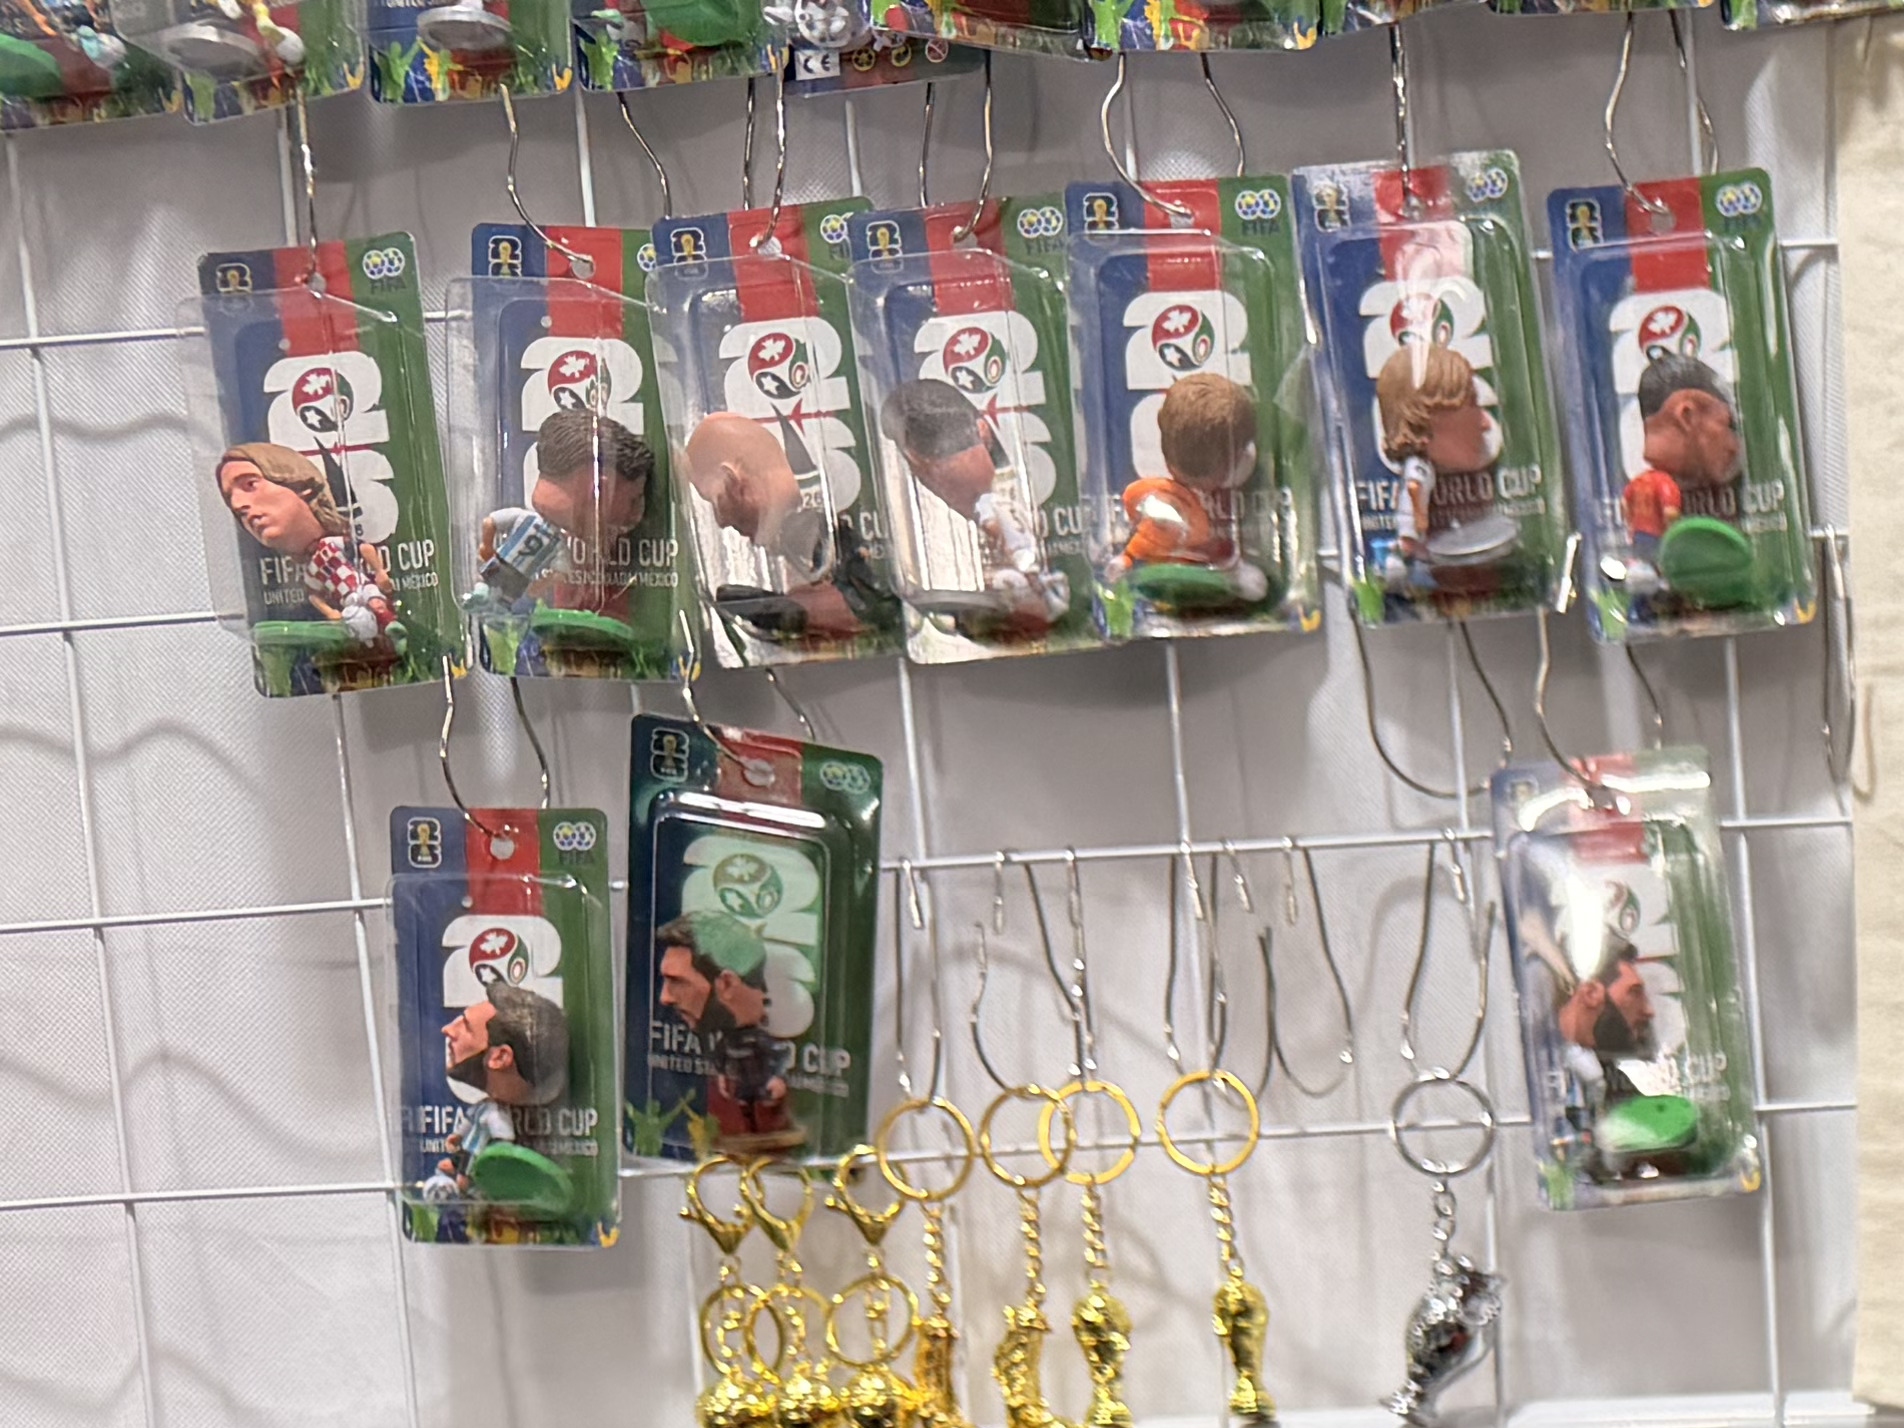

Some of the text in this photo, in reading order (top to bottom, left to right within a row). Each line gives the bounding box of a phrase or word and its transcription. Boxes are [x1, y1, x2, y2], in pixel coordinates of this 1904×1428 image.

[1434, 471, 1494, 507] ORLD
[398, 539, 435, 570] CUP
[638, 538, 679, 567] CUP
[558, 1108, 599, 1136] CUP
